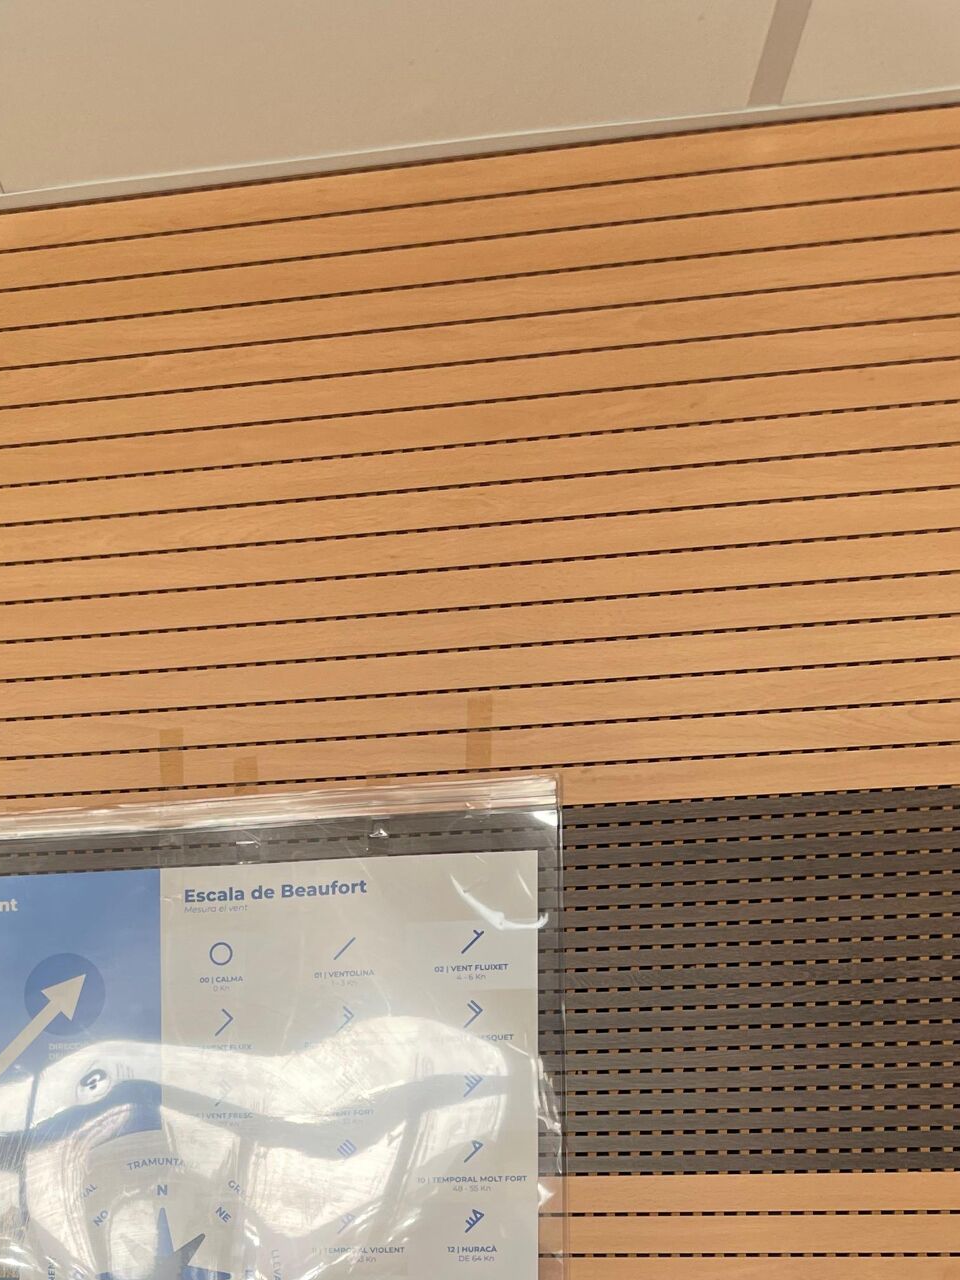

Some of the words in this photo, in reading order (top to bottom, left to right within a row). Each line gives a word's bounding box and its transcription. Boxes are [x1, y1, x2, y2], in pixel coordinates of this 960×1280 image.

[184, 888, 244, 903] Escala
[251, 885, 275, 899] de
[281, 880, 367, 898] Beaufort
[229, 904, 248, 912] vent
[450, 965, 473, 973] VENT
[474, 964, 508, 972] FLUIXET
[216, 975, 243, 983] CALMA
[157, 1184, 168, 1196] N
[93, 1210, 109, 1227] NO
[216, 1206, 232, 1223] NE
